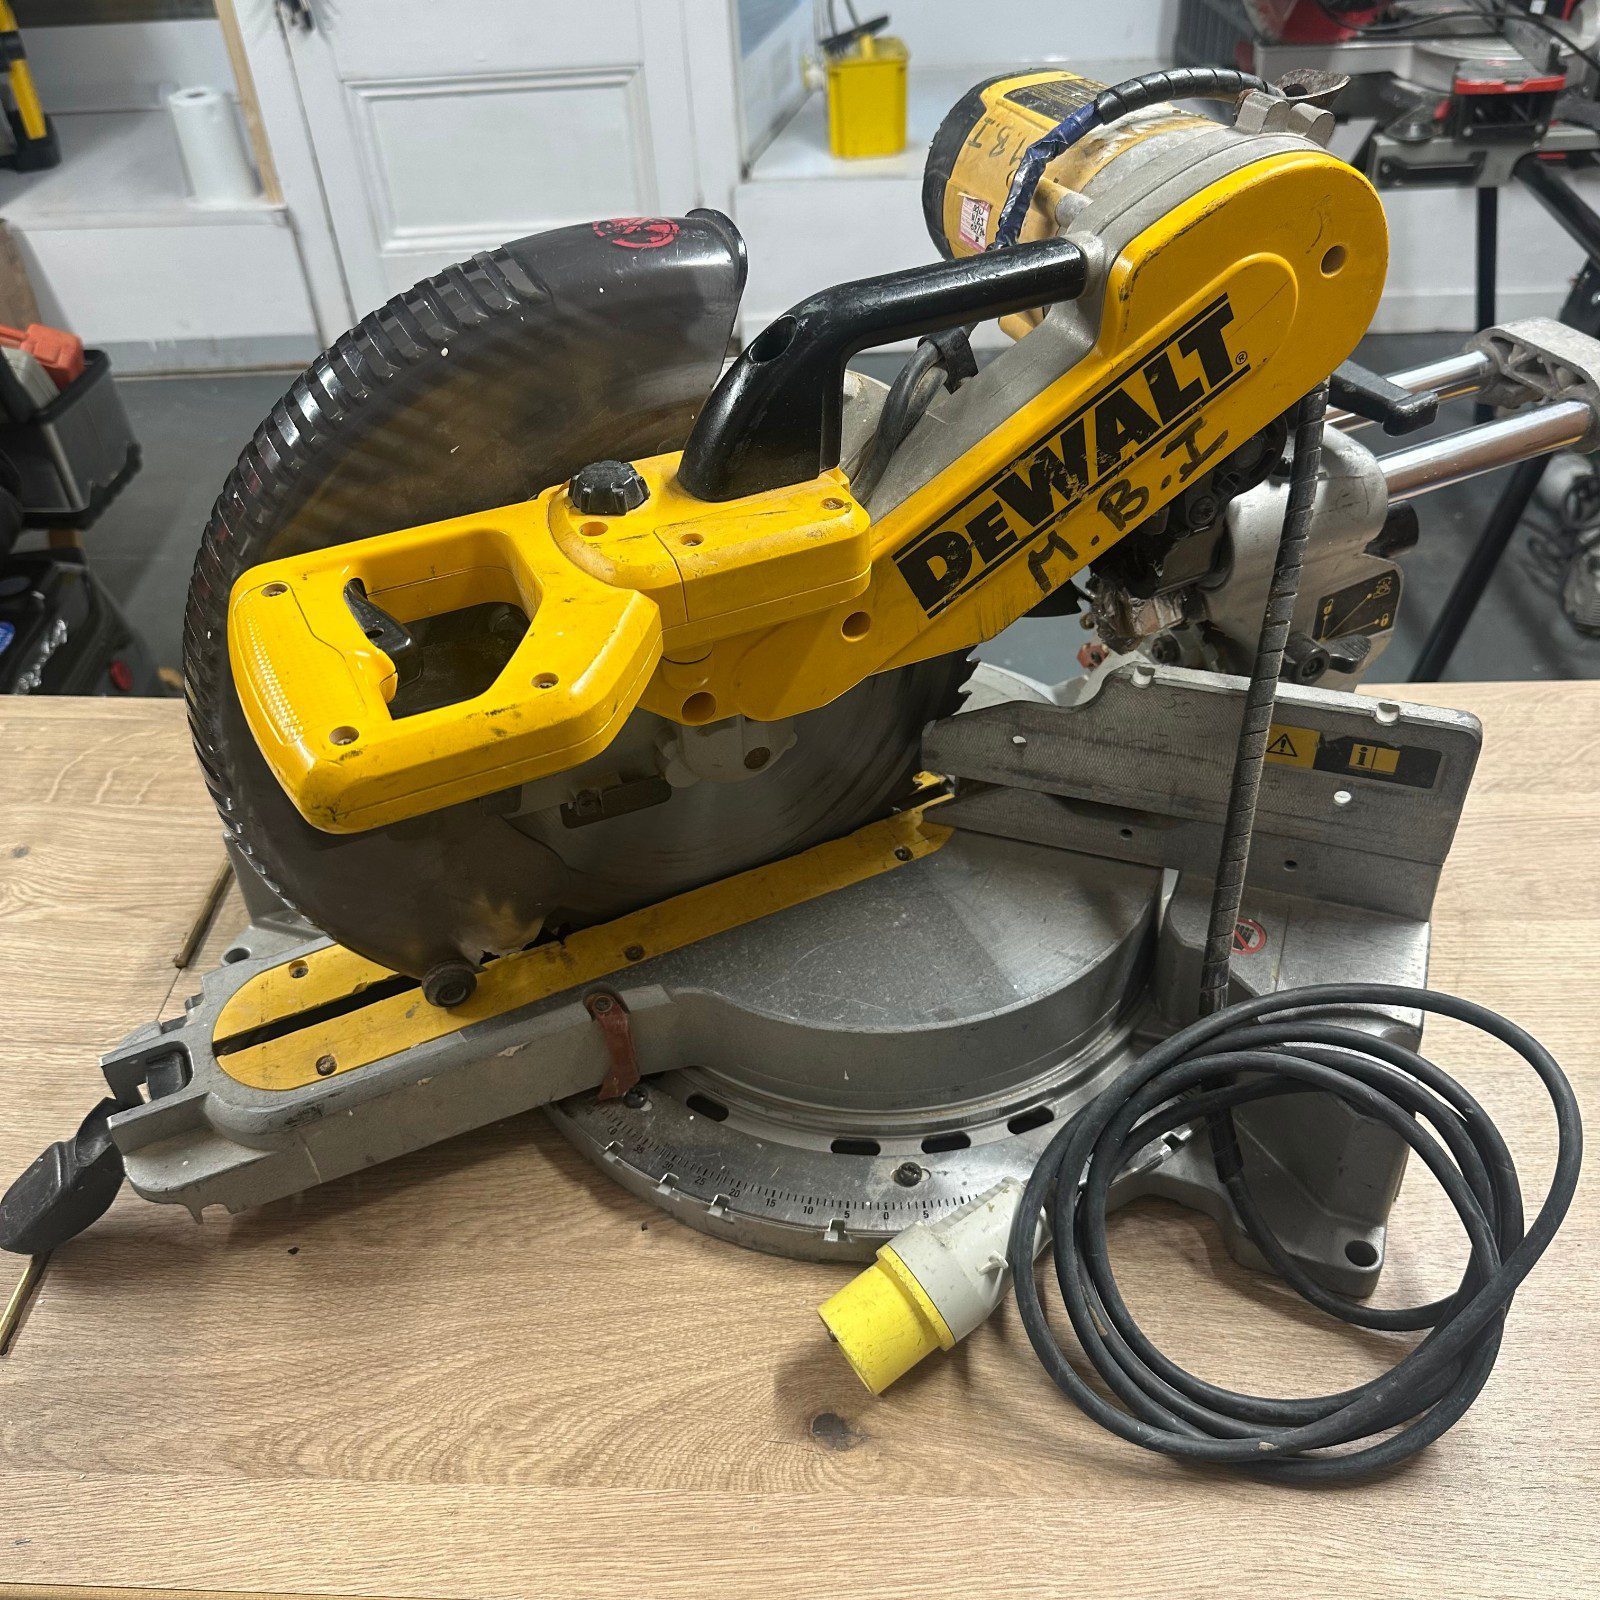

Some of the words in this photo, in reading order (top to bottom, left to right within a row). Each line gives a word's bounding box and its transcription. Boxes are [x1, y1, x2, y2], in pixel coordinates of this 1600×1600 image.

[662, 1161, 674, 1170] 30
[694, 1176, 706, 1185] 25
[728, 1188, 740, 1198] 20
[766, 1198, 776, 1207] 15
[803, 1206, 813, 1215] 10
[844, 1211, 850, 1219] 5
[883, 1211, 889, 1220] 0
[923, 1210, 929, 1219] 5
